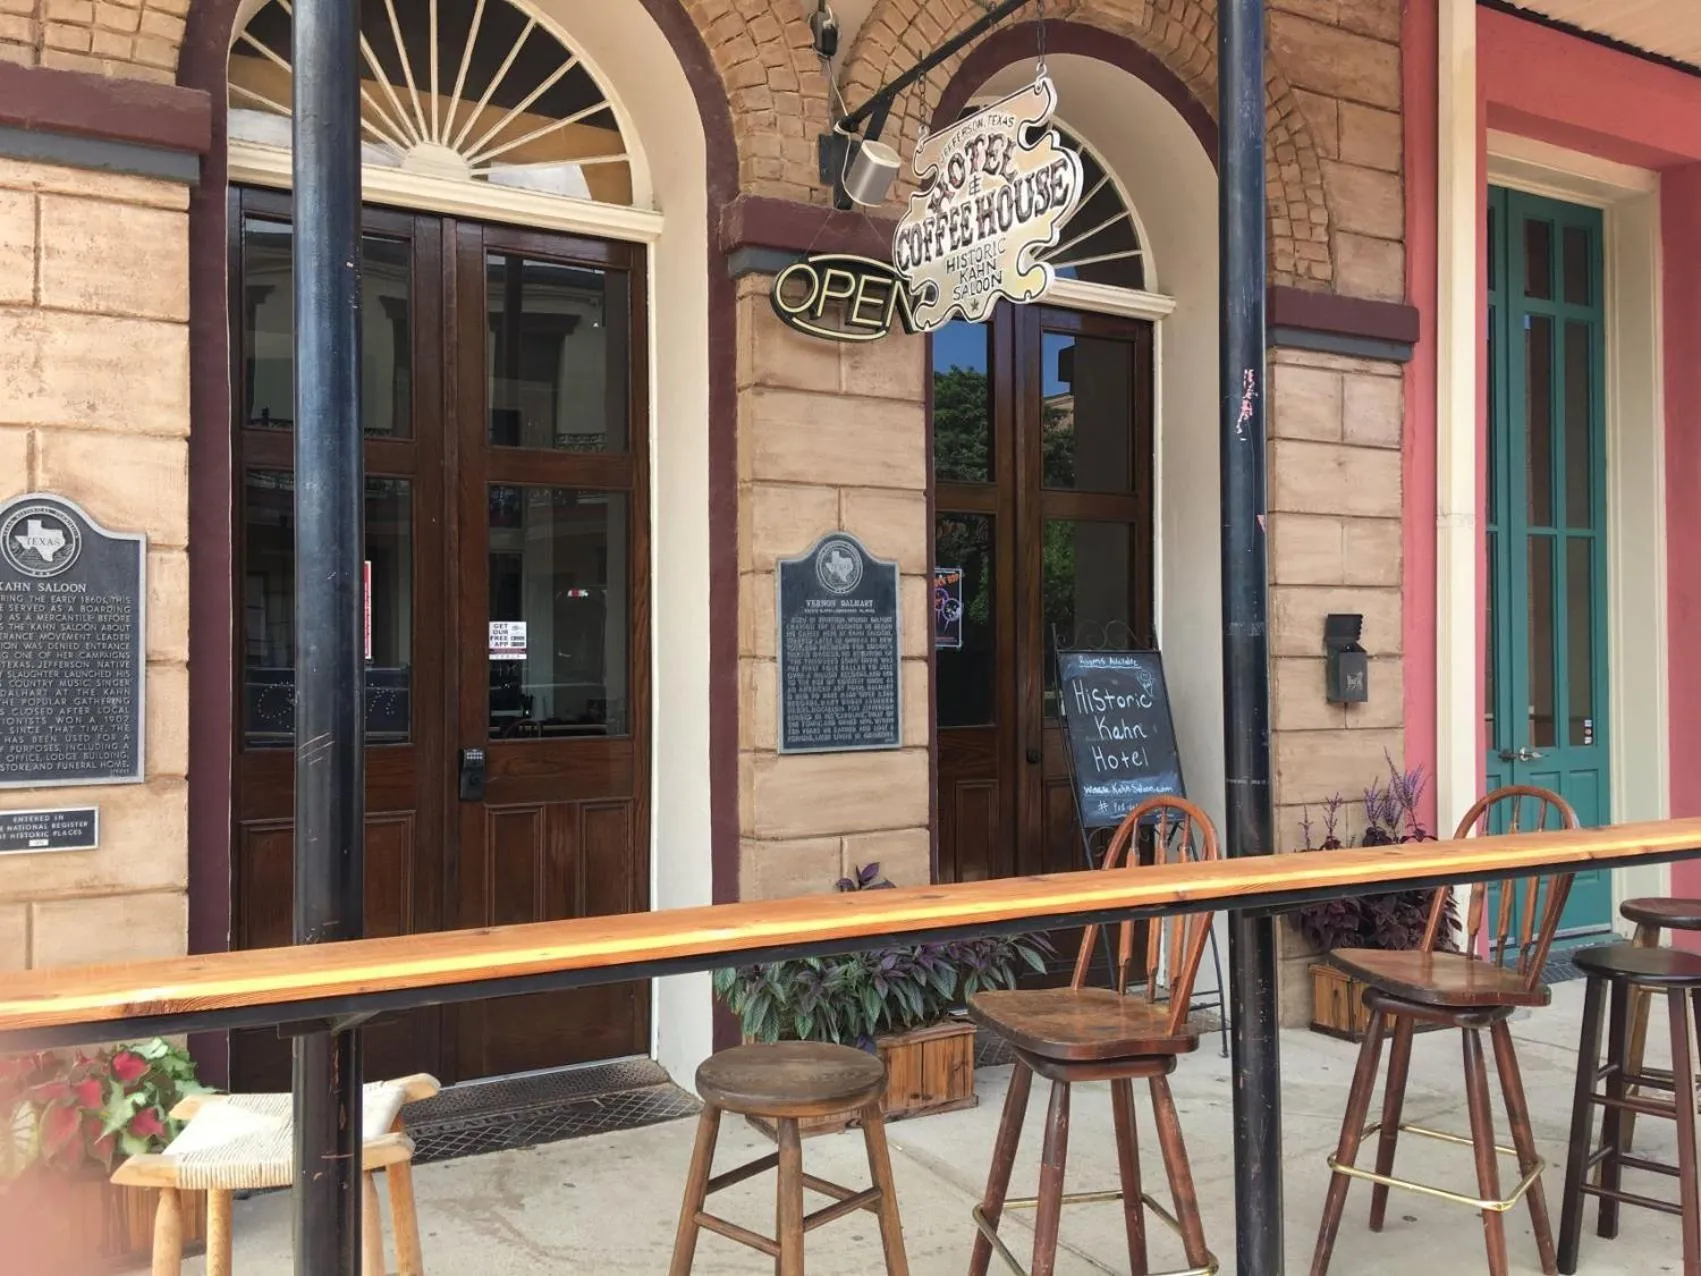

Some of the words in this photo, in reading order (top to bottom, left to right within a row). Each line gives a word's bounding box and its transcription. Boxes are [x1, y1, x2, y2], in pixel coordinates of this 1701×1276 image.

[987, 114, 1015, 129] TEXAS
[928, 132, 1017, 214] HOTEL
[946, 237, 1006, 275] HISTORIC
[960, 258, 997, 284] KAHN
[953, 270, 1003, 301] SALOON
[776, 263, 922, 333] OPEN
[27, 537, 60, 546] TEXAS
[38, 583, 87, 593] SALOON
[8, 604, 46, 612] SERVED
[51, 604, 63, 612] AS
[80, 605, 131, 613] BOARDING
[98, 614, 130, 622] BEFORE
[31, 623, 56, 631] KAHN
[61, 623, 97, 631] SALOON
[101, 623, 131, 632] ABOUT
[40, 633, 91, 641] MOVEMENT
[97, 633, 130, 641] LEADER
[23, 642, 43, 650] WAS
[48, 642, 80, 650] DENIED
[86, 642, 130, 650] ENTRANCE
[14, 651, 33, 659] ONE
[39, 651, 52, 659] OF
[57, 651, 74, 659] HER
[80, 651, 131, 660] CAMPAIGNS
[38, 660, 90, 669] JEFFERSON
[97, 660, 130, 669] NATIVE
[7, 670, 59, 678] SLAUGHTER
[64, 670, 112, 678] LAUNCHED
[116, 669, 131, 678] HIS
[8, 679, 54, 688] COUNTRY
[96, 679, 130, 687] SINGER
[56, 688, 68, 696] AT
[77, 688, 96, 696] THE
[103, 688, 130, 696] KAHN
[21, 698, 67, 707] POPULAR
[74, 697, 130, 706] GATHERING
[11, 707, 54, 716] CLOSED
[60, 706, 90, 715] AFTER
[97, 706, 129, 714] LOCAL
[56, 715, 82, 725] WON
[89, 715, 96, 723] A
[9, 725, 40, 735] SINCE
[48, 725, 76, 734] THAT
[111, 723, 130, 732] THE
[1094, 715, 1148, 741] Kahn
[4, 735, 25, 744] HAS
[32, 735, 58, 744] BEEN
[65, 734, 91, 743] USED
[97, 733, 117, 742] FOR
[123, 733, 129, 741] A
[66, 742, 119, 751] INCLUDING
[123, 741, 130, 749] A
[46, 751, 77, 761] LODGE
[1091, 745, 1150, 772] Hotel
[32, 761, 53, 771] AND
[57, 760, 98, 770] FUNERAL
[13, 815, 50, 823] ENTERED
[7, 823, 48, 832] NATIONAL
[51, 821, 88, 829] REGISTER
[10, 831, 49, 840] HISTORIC
[52, 829, 83, 837] PLACES
